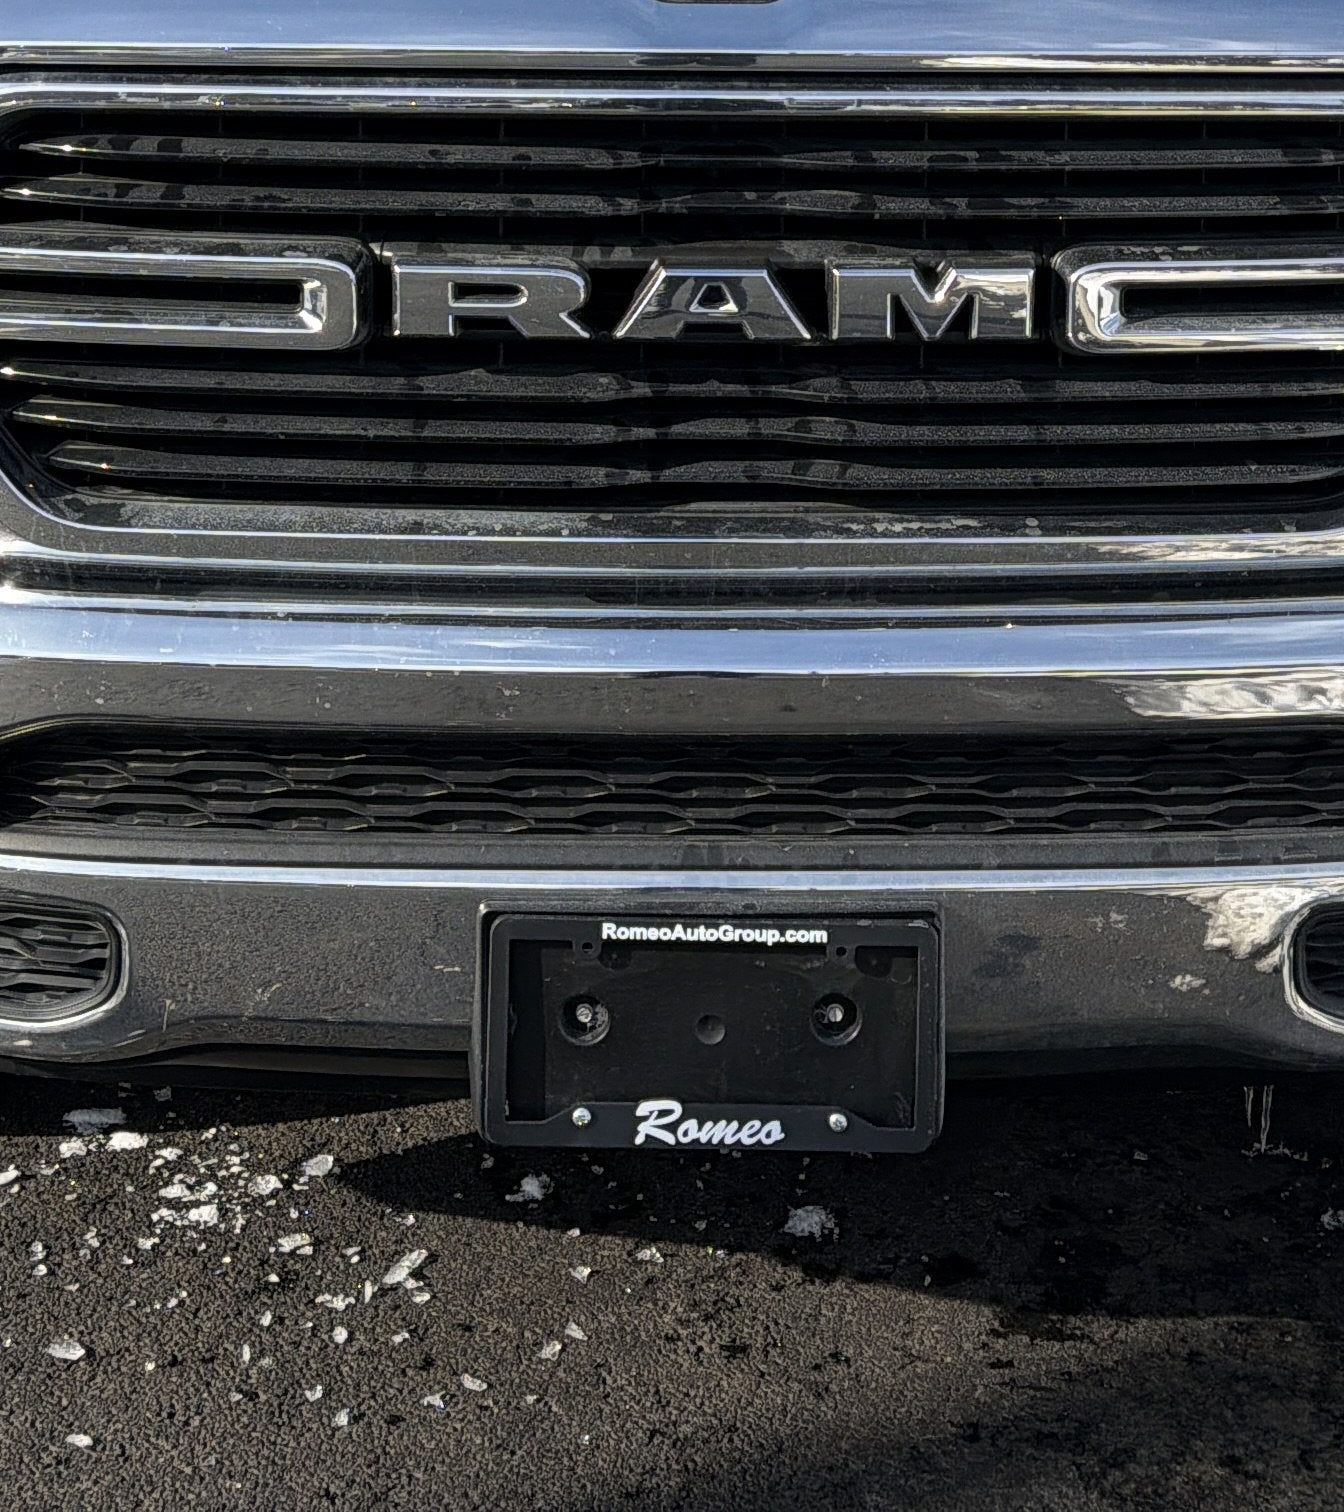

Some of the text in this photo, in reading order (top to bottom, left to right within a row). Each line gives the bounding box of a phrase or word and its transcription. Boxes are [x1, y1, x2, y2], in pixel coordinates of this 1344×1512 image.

[391, 262, 1035, 339] RAM
[602, 922, 828, 946] RomeoAutoGroup.com
[634, 1099, 786, 1146] Romeo
